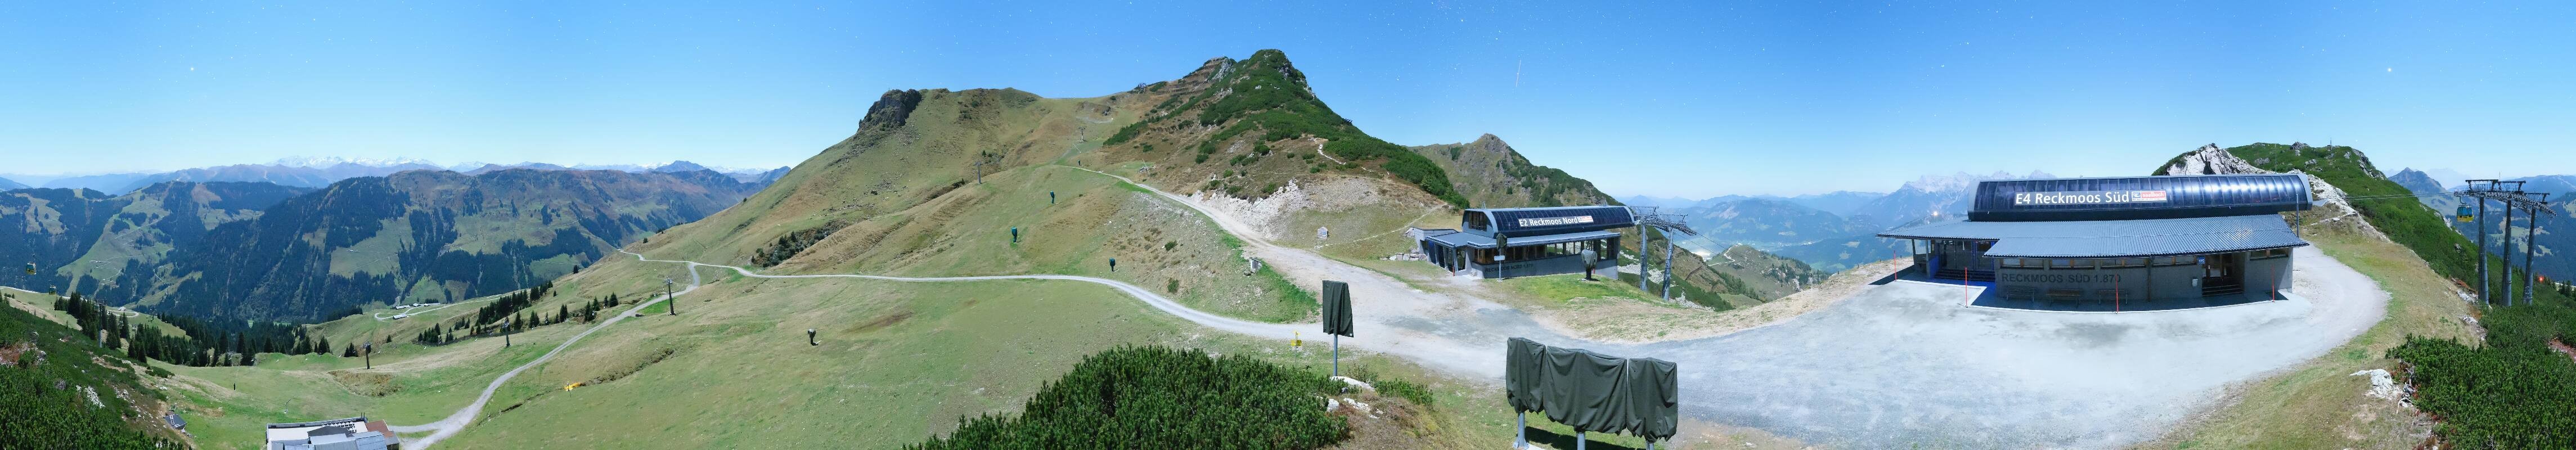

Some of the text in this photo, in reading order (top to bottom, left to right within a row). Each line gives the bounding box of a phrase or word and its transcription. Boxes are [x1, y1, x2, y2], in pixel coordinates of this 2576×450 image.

[2016, 191, 2129, 204] E4 Reckmoos Süd
[1529, 218, 1562, 226] Reckmoos
[1563, 217, 1579, 225] Nord
[2001, 273, 2063, 283] RECKMOOS
[2069, 273, 2091, 283] SÜD
